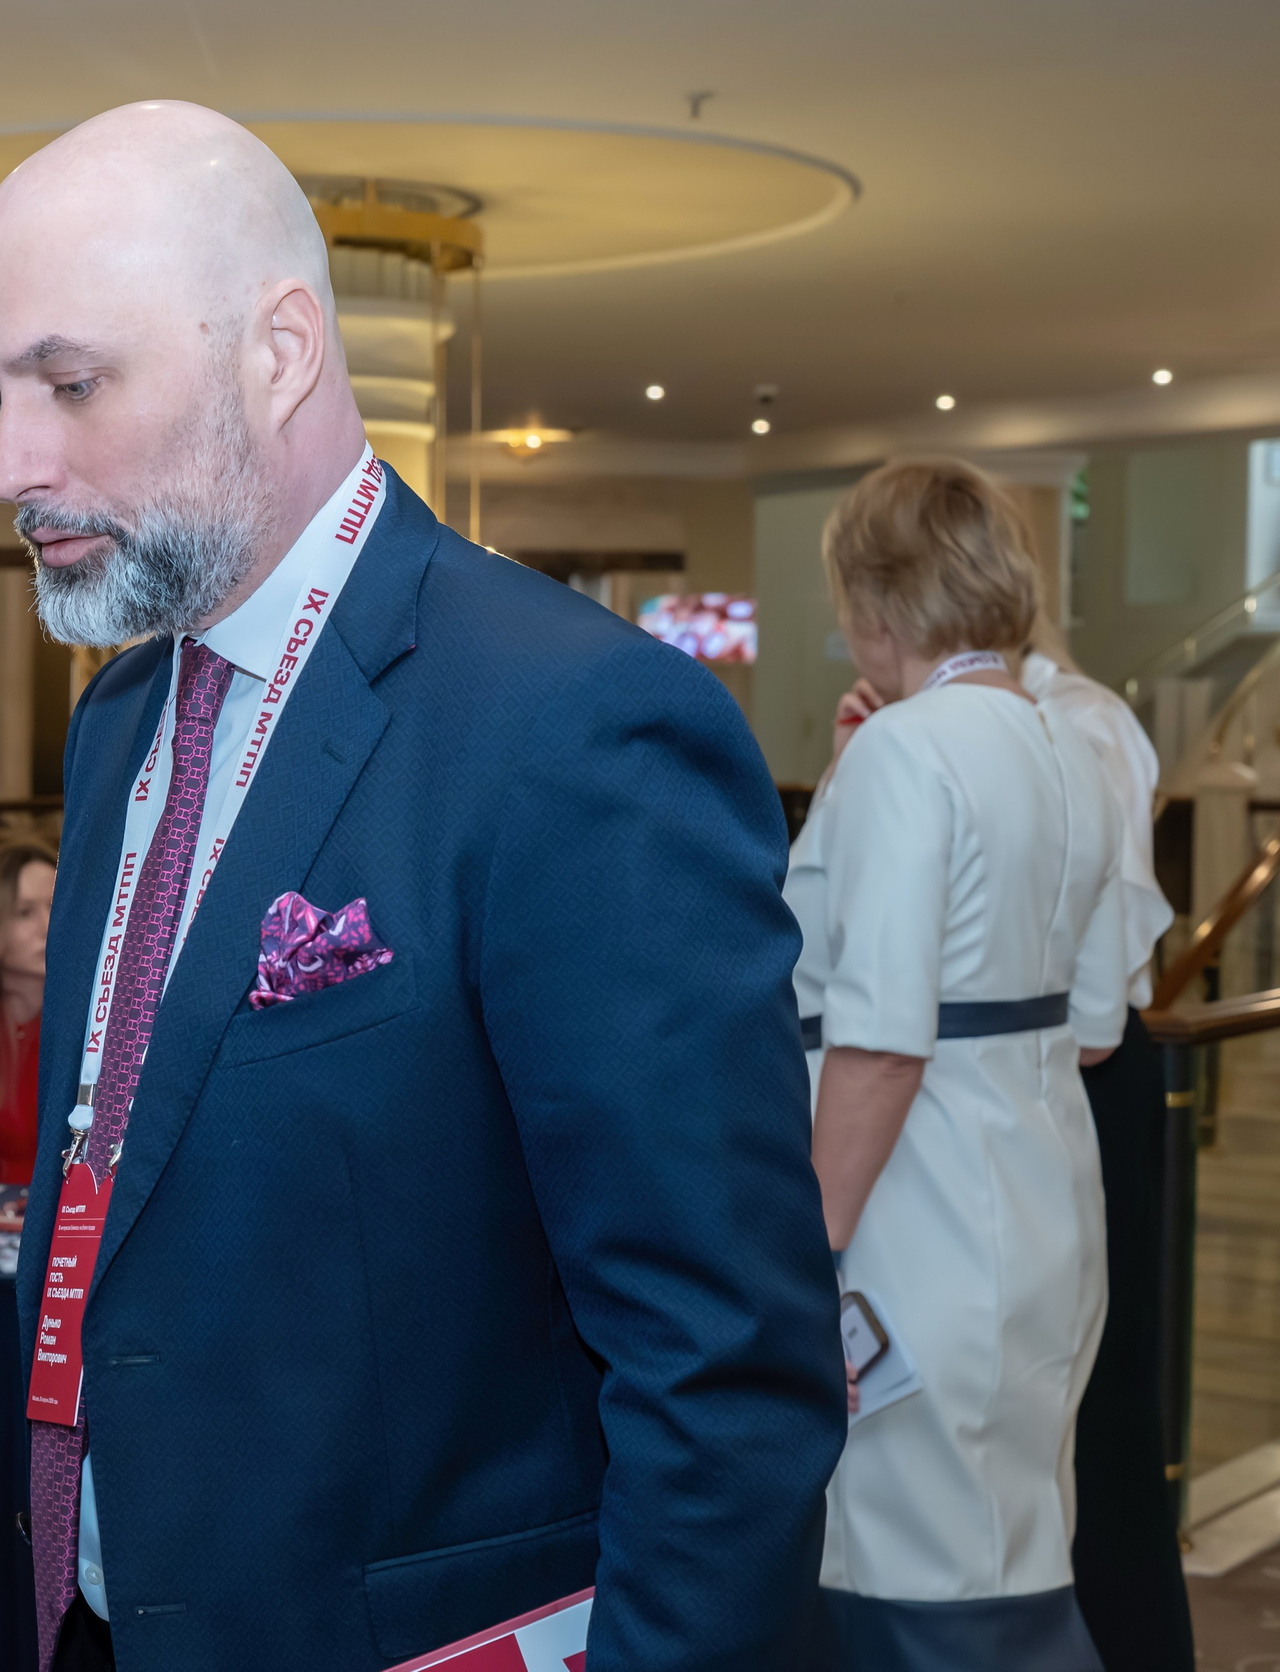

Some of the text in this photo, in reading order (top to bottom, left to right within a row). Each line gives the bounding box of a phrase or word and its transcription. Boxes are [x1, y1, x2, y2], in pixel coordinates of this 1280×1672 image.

[334, 478, 380, 545] МТПП
[235, 587, 330, 788] IX СЪЕЗД МТПП
[134, 777, 152, 802] IX
[208, 838, 225, 862] IX
[85, 852, 137, 1054] IX СЪЕЗД МТПП
[52, 1255, 77, 1268] ПОЧЕТНЫЙ
[49, 1272, 64, 1283] ГОСТЬ
[39, 1331, 57, 1346] Роман
[37, 1348, 67, 1367] Викторович
